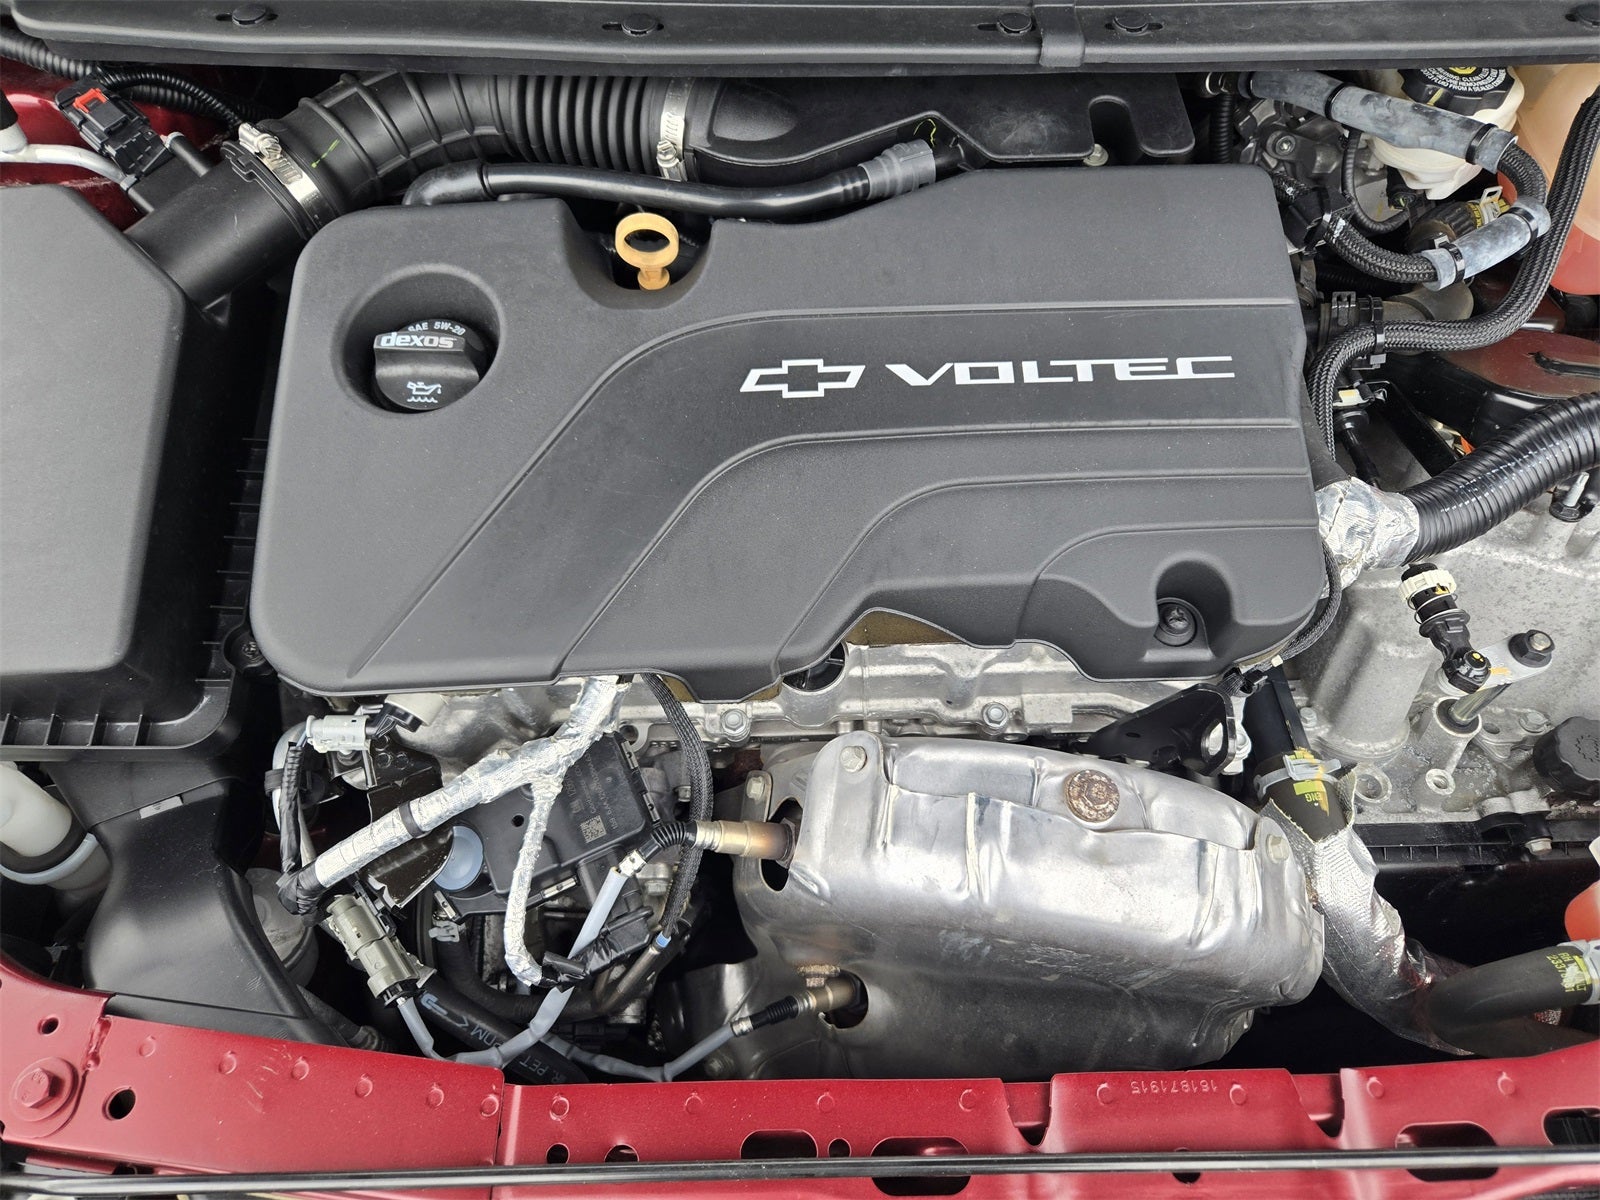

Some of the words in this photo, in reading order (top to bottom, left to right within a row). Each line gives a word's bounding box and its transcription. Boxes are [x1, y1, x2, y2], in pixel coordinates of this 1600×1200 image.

[409, 322, 429, 332] SAE
[434, 322, 466, 335] 5W-20
[380, 331, 458, 349] dexos
[885, 355, 1236, 387] VOLTEC
[1304, 792, 1321, 803] ENG
[519, 1055, 549, 1075] PET
